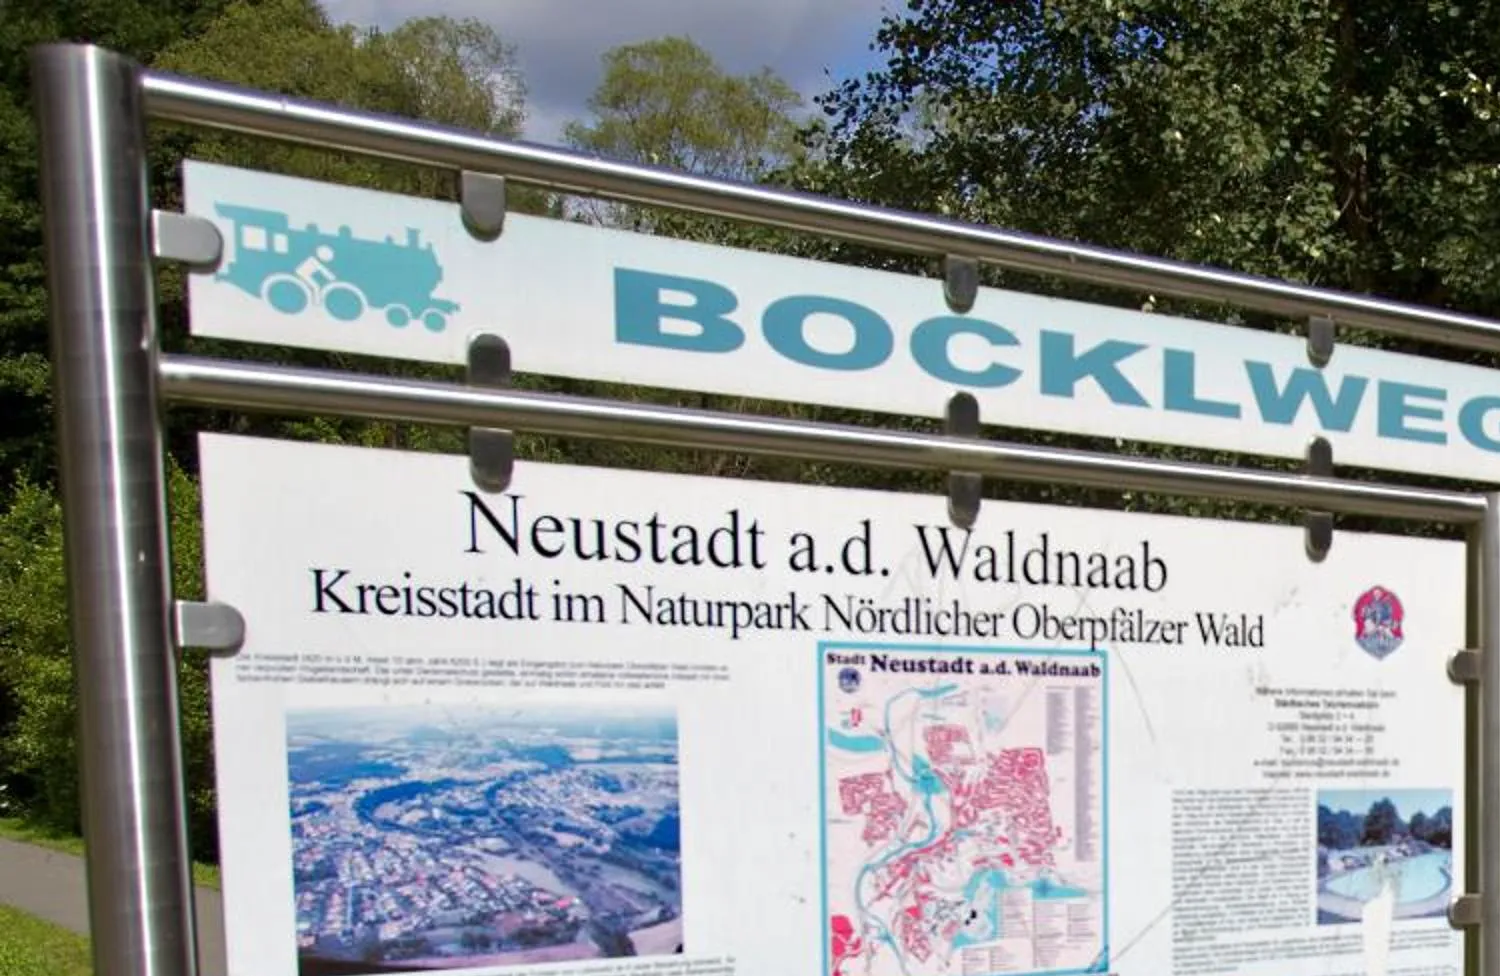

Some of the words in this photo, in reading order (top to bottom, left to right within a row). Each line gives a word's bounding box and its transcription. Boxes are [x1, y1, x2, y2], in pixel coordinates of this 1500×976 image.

[459, 490, 767, 569] Neustadt
[789, 519, 889, 577] a.d.
[914, 523, 1167, 592] Waldnaab
[312, 568, 540, 621] Kreisstadt
[553, 579, 606, 623] im
[615, 583, 812, 640] Naturpark
[823, 593, 1005, 638] Nördlicher
[1013, 601, 1189, 652] Oberpfälzer
[1195, 612, 1265, 648] Wald
[827, 653, 866, 665] Stadt
[869, 654, 974, 675] Neustadt
[980, 660, 1012, 675] a.d.
[1016, 661, 1101, 677] Waldnaab
